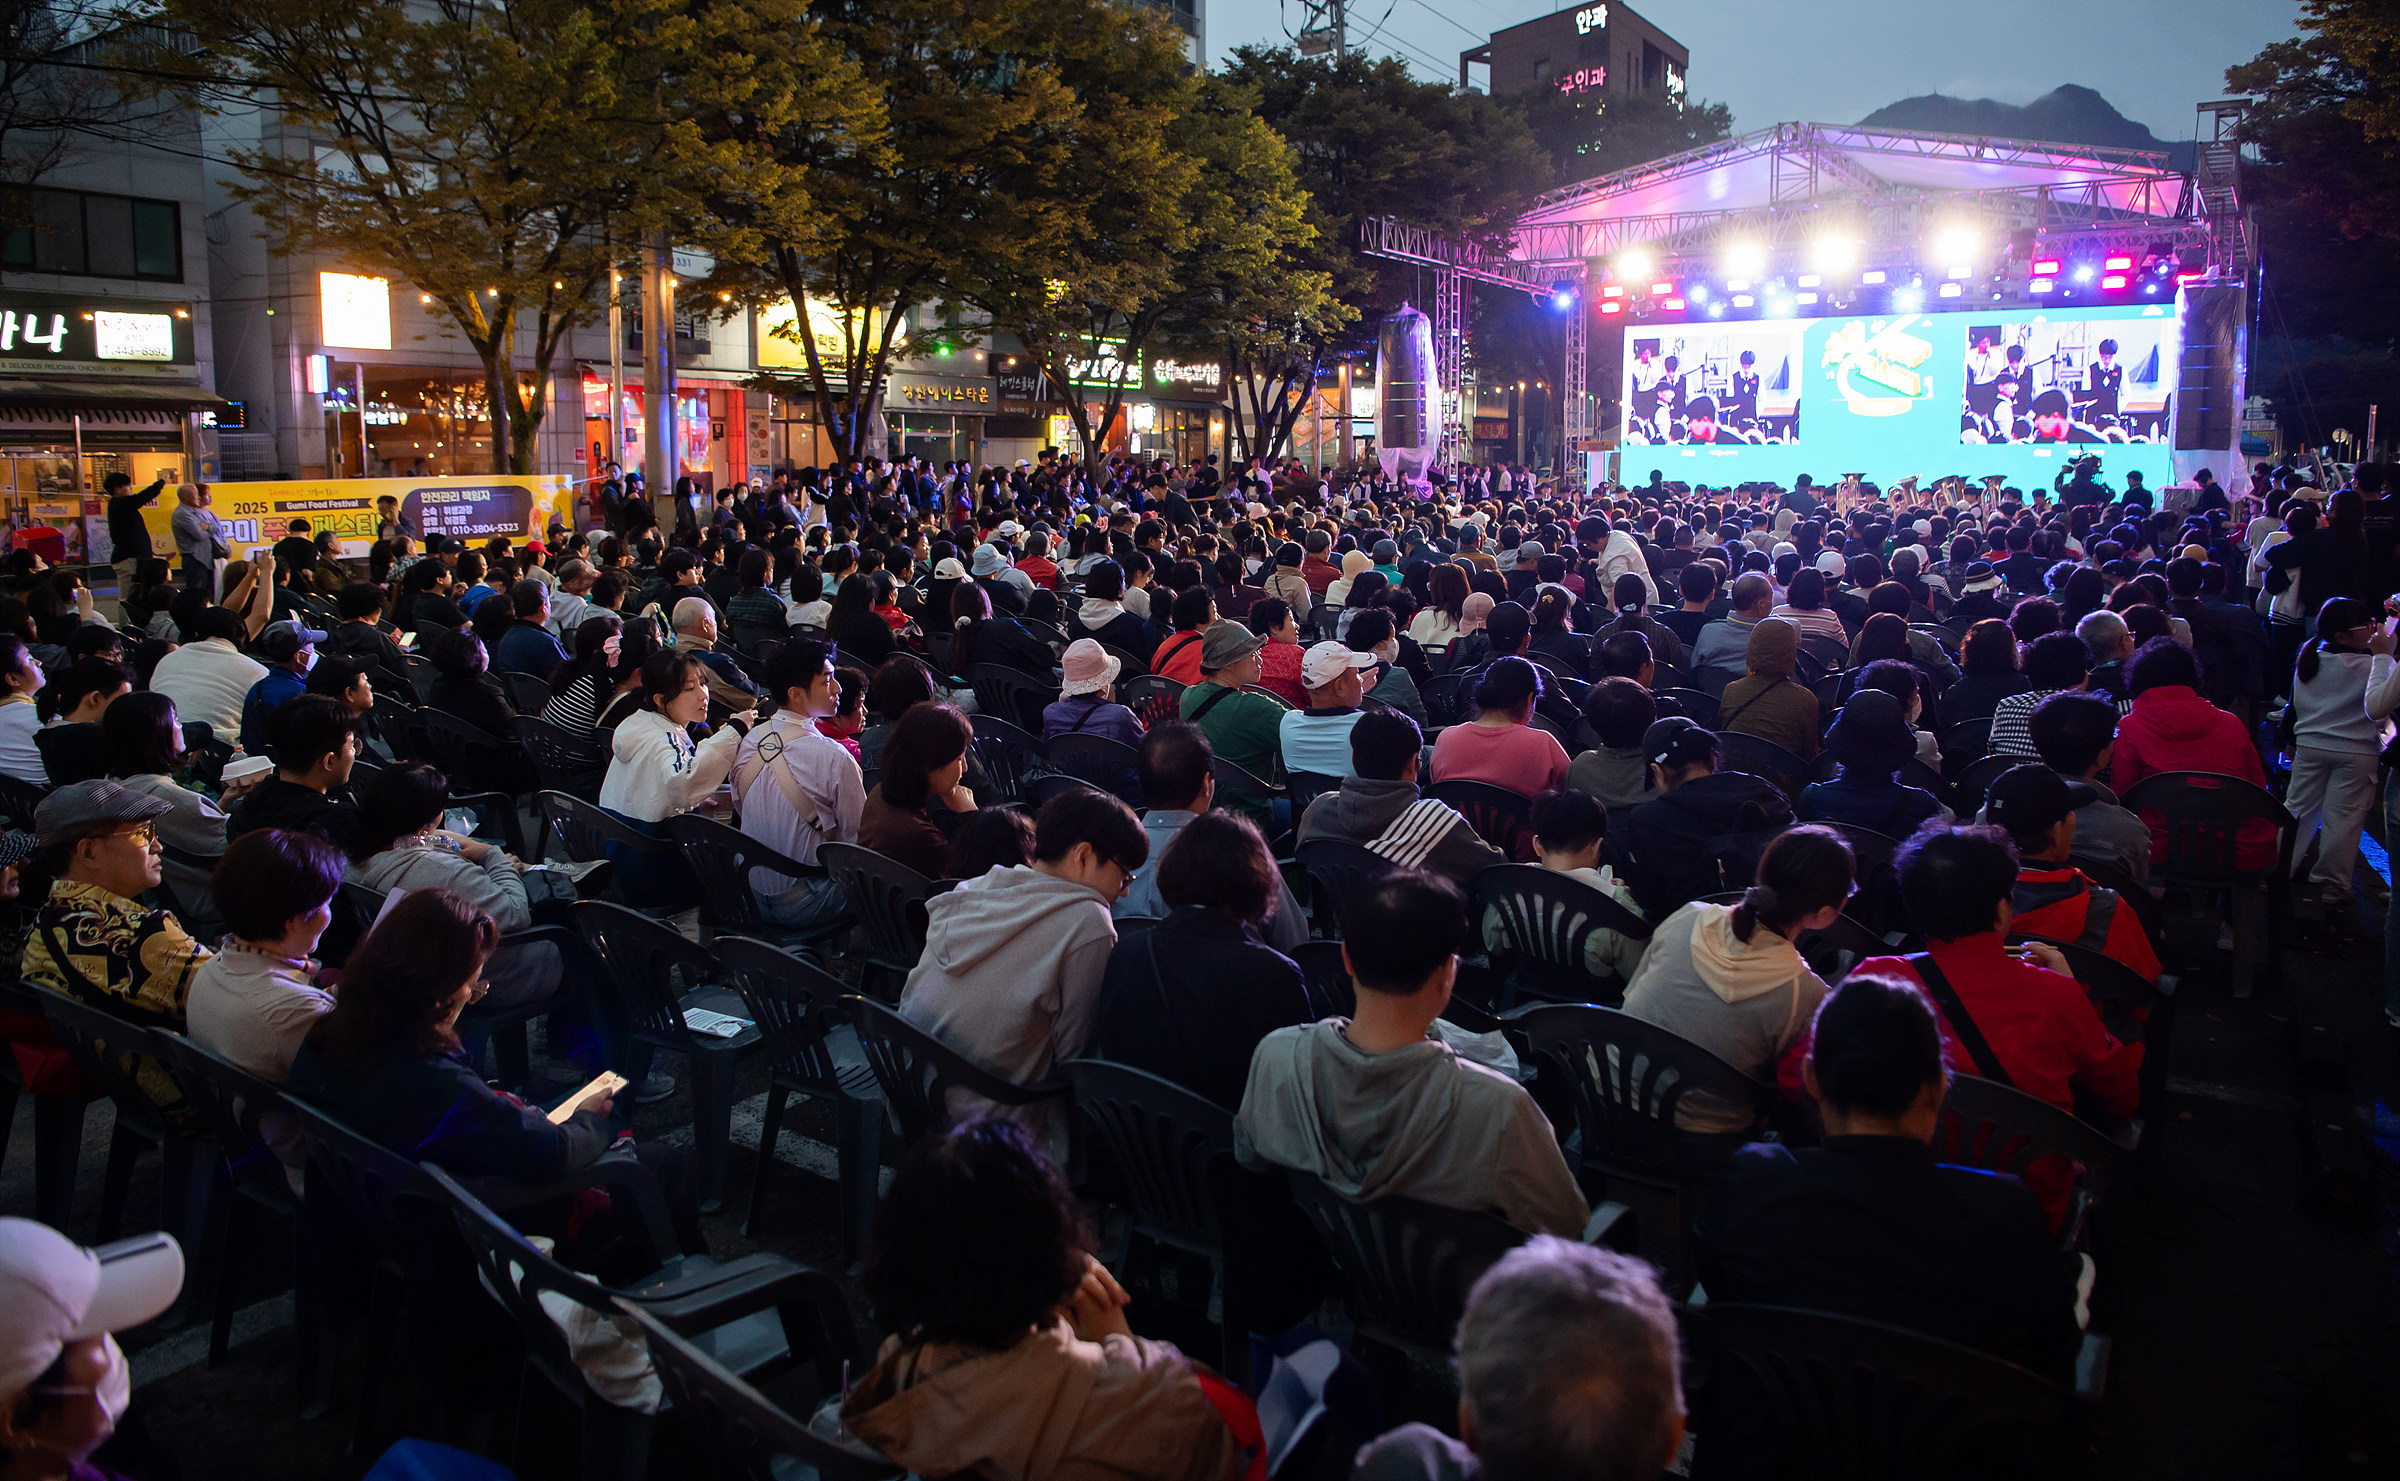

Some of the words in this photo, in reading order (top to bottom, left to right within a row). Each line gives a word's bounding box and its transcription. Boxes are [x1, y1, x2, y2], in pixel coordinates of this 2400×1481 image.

[1576, 4, 1608, 35] 안과
[1553, 65, 1607, 97] 부인과
[421, 491, 460, 503] 안전관리
[461, 489, 491, 502] 책임자
[233, 501, 269, 515] 2025
[286, 501, 307, 510] Gumi
[308, 500, 328, 509] Food
[328, 499, 359, 509] Festival
[421, 506, 438, 517] 소속
[312, 512, 384, 538] 페스티
[452, 523, 519, 535] 010-3804-5323
